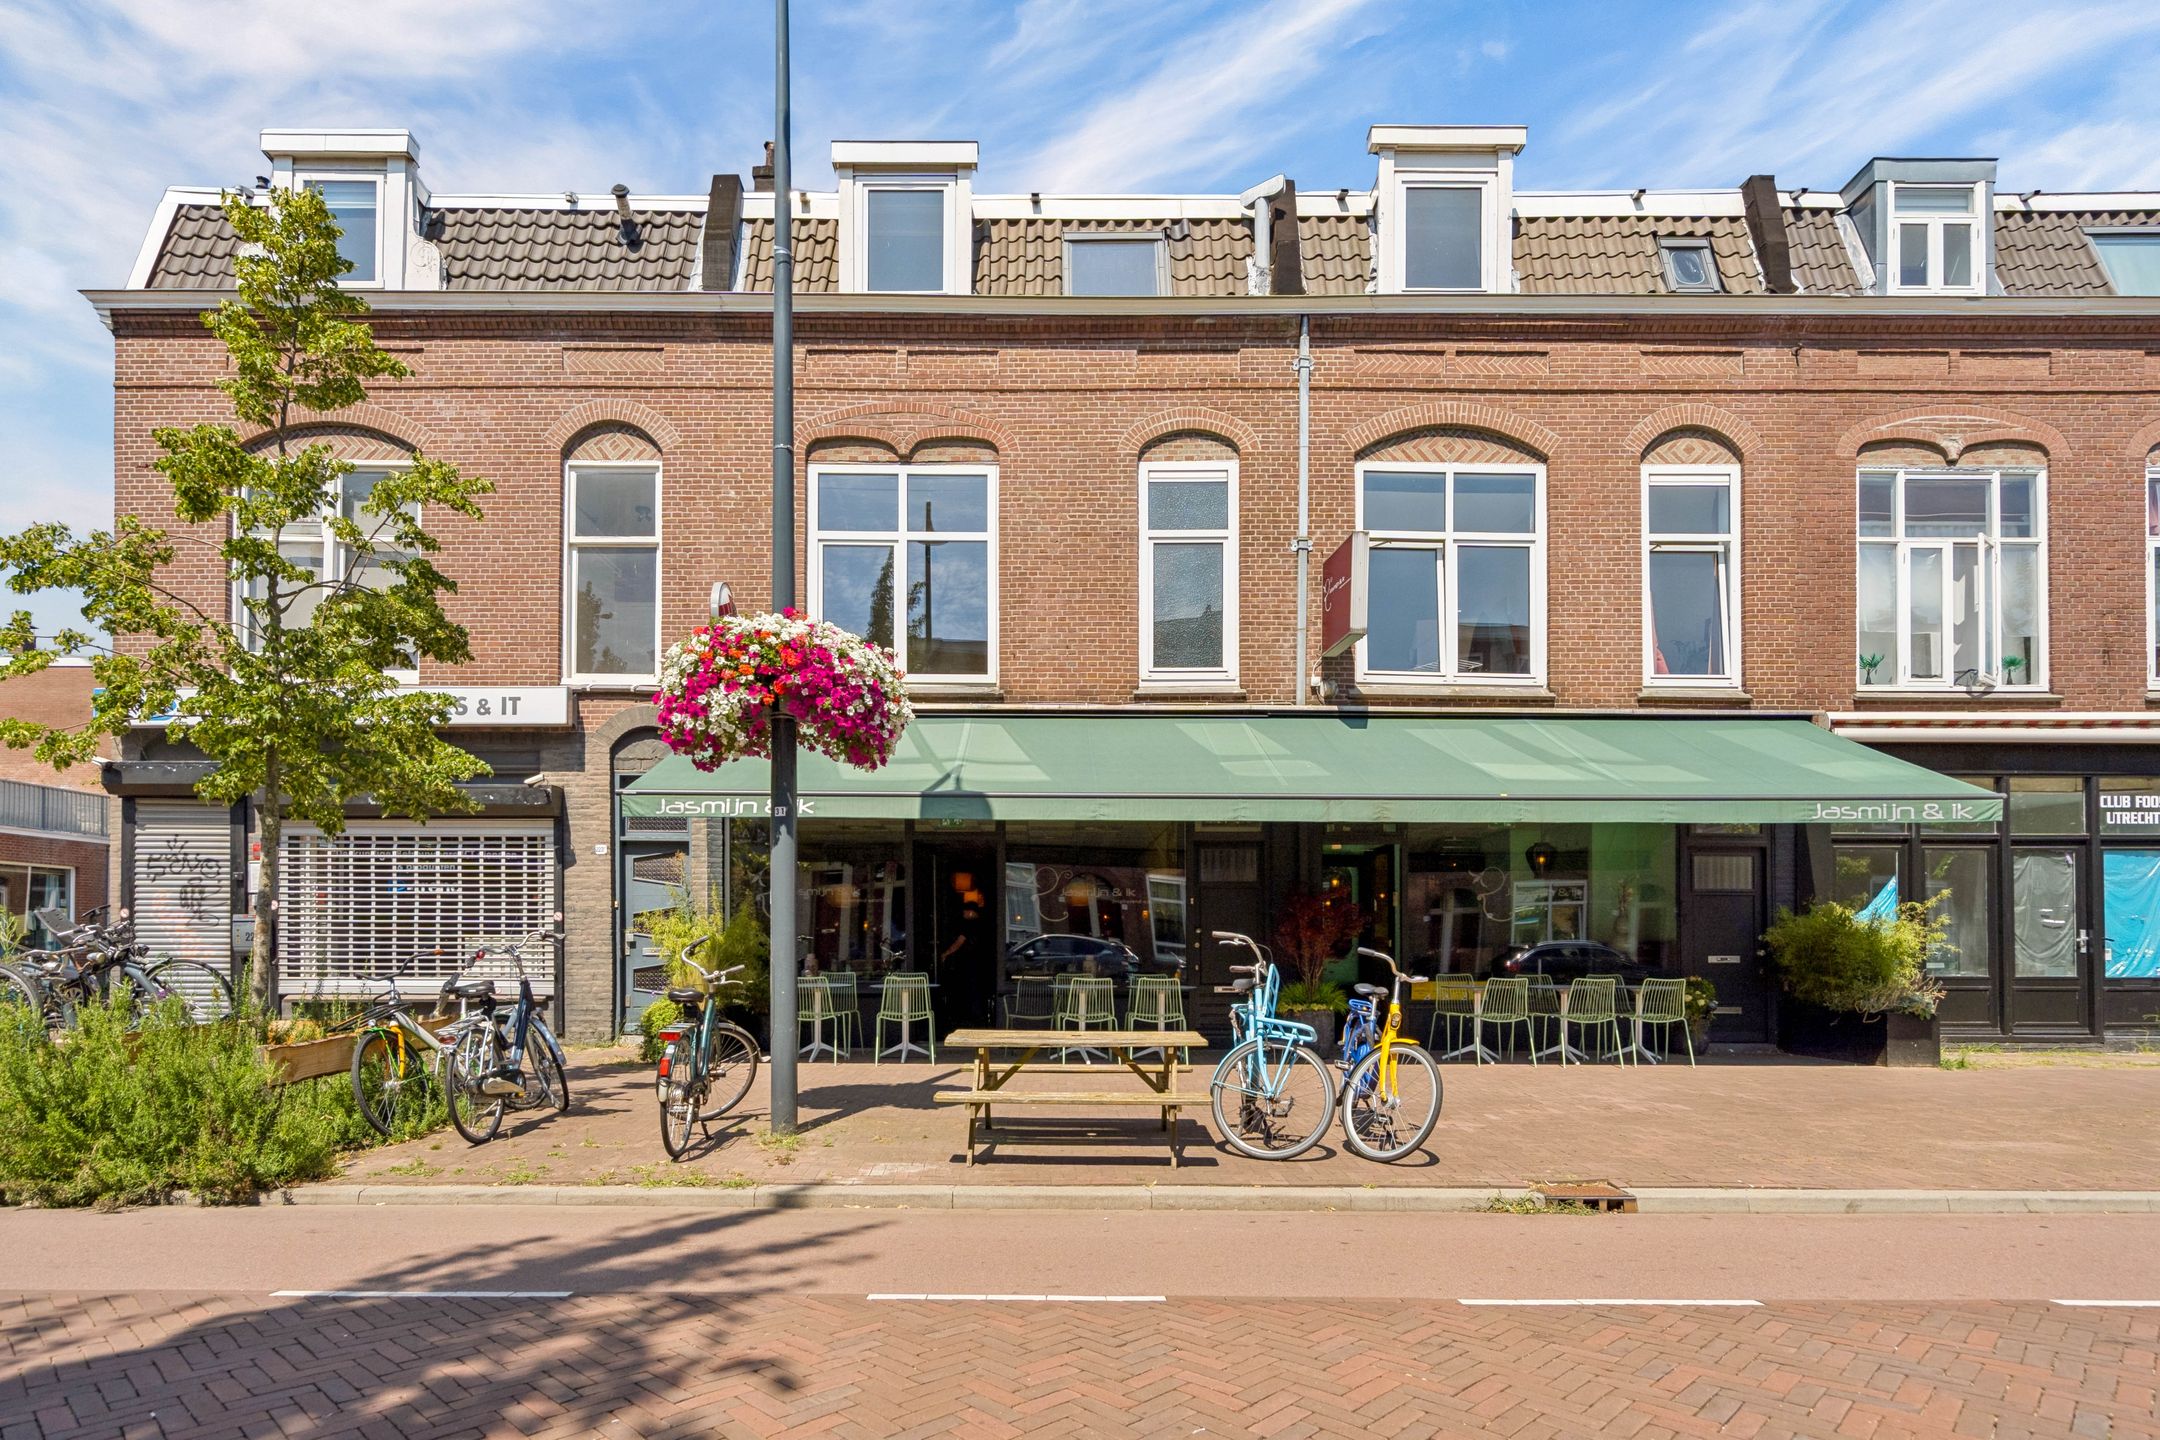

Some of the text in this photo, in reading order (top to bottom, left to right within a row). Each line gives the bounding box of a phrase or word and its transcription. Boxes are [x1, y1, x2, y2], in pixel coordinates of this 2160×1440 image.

[476, 698, 491, 716] &
[501, 696, 521, 715] IT
[655, 798, 758, 816] Jasmijn
[2100, 795, 2160, 808] CLUB FOO
[1812, 803, 1973, 821] Jasmijn & ik
[2106, 811, 2160, 824] UTRECHT
